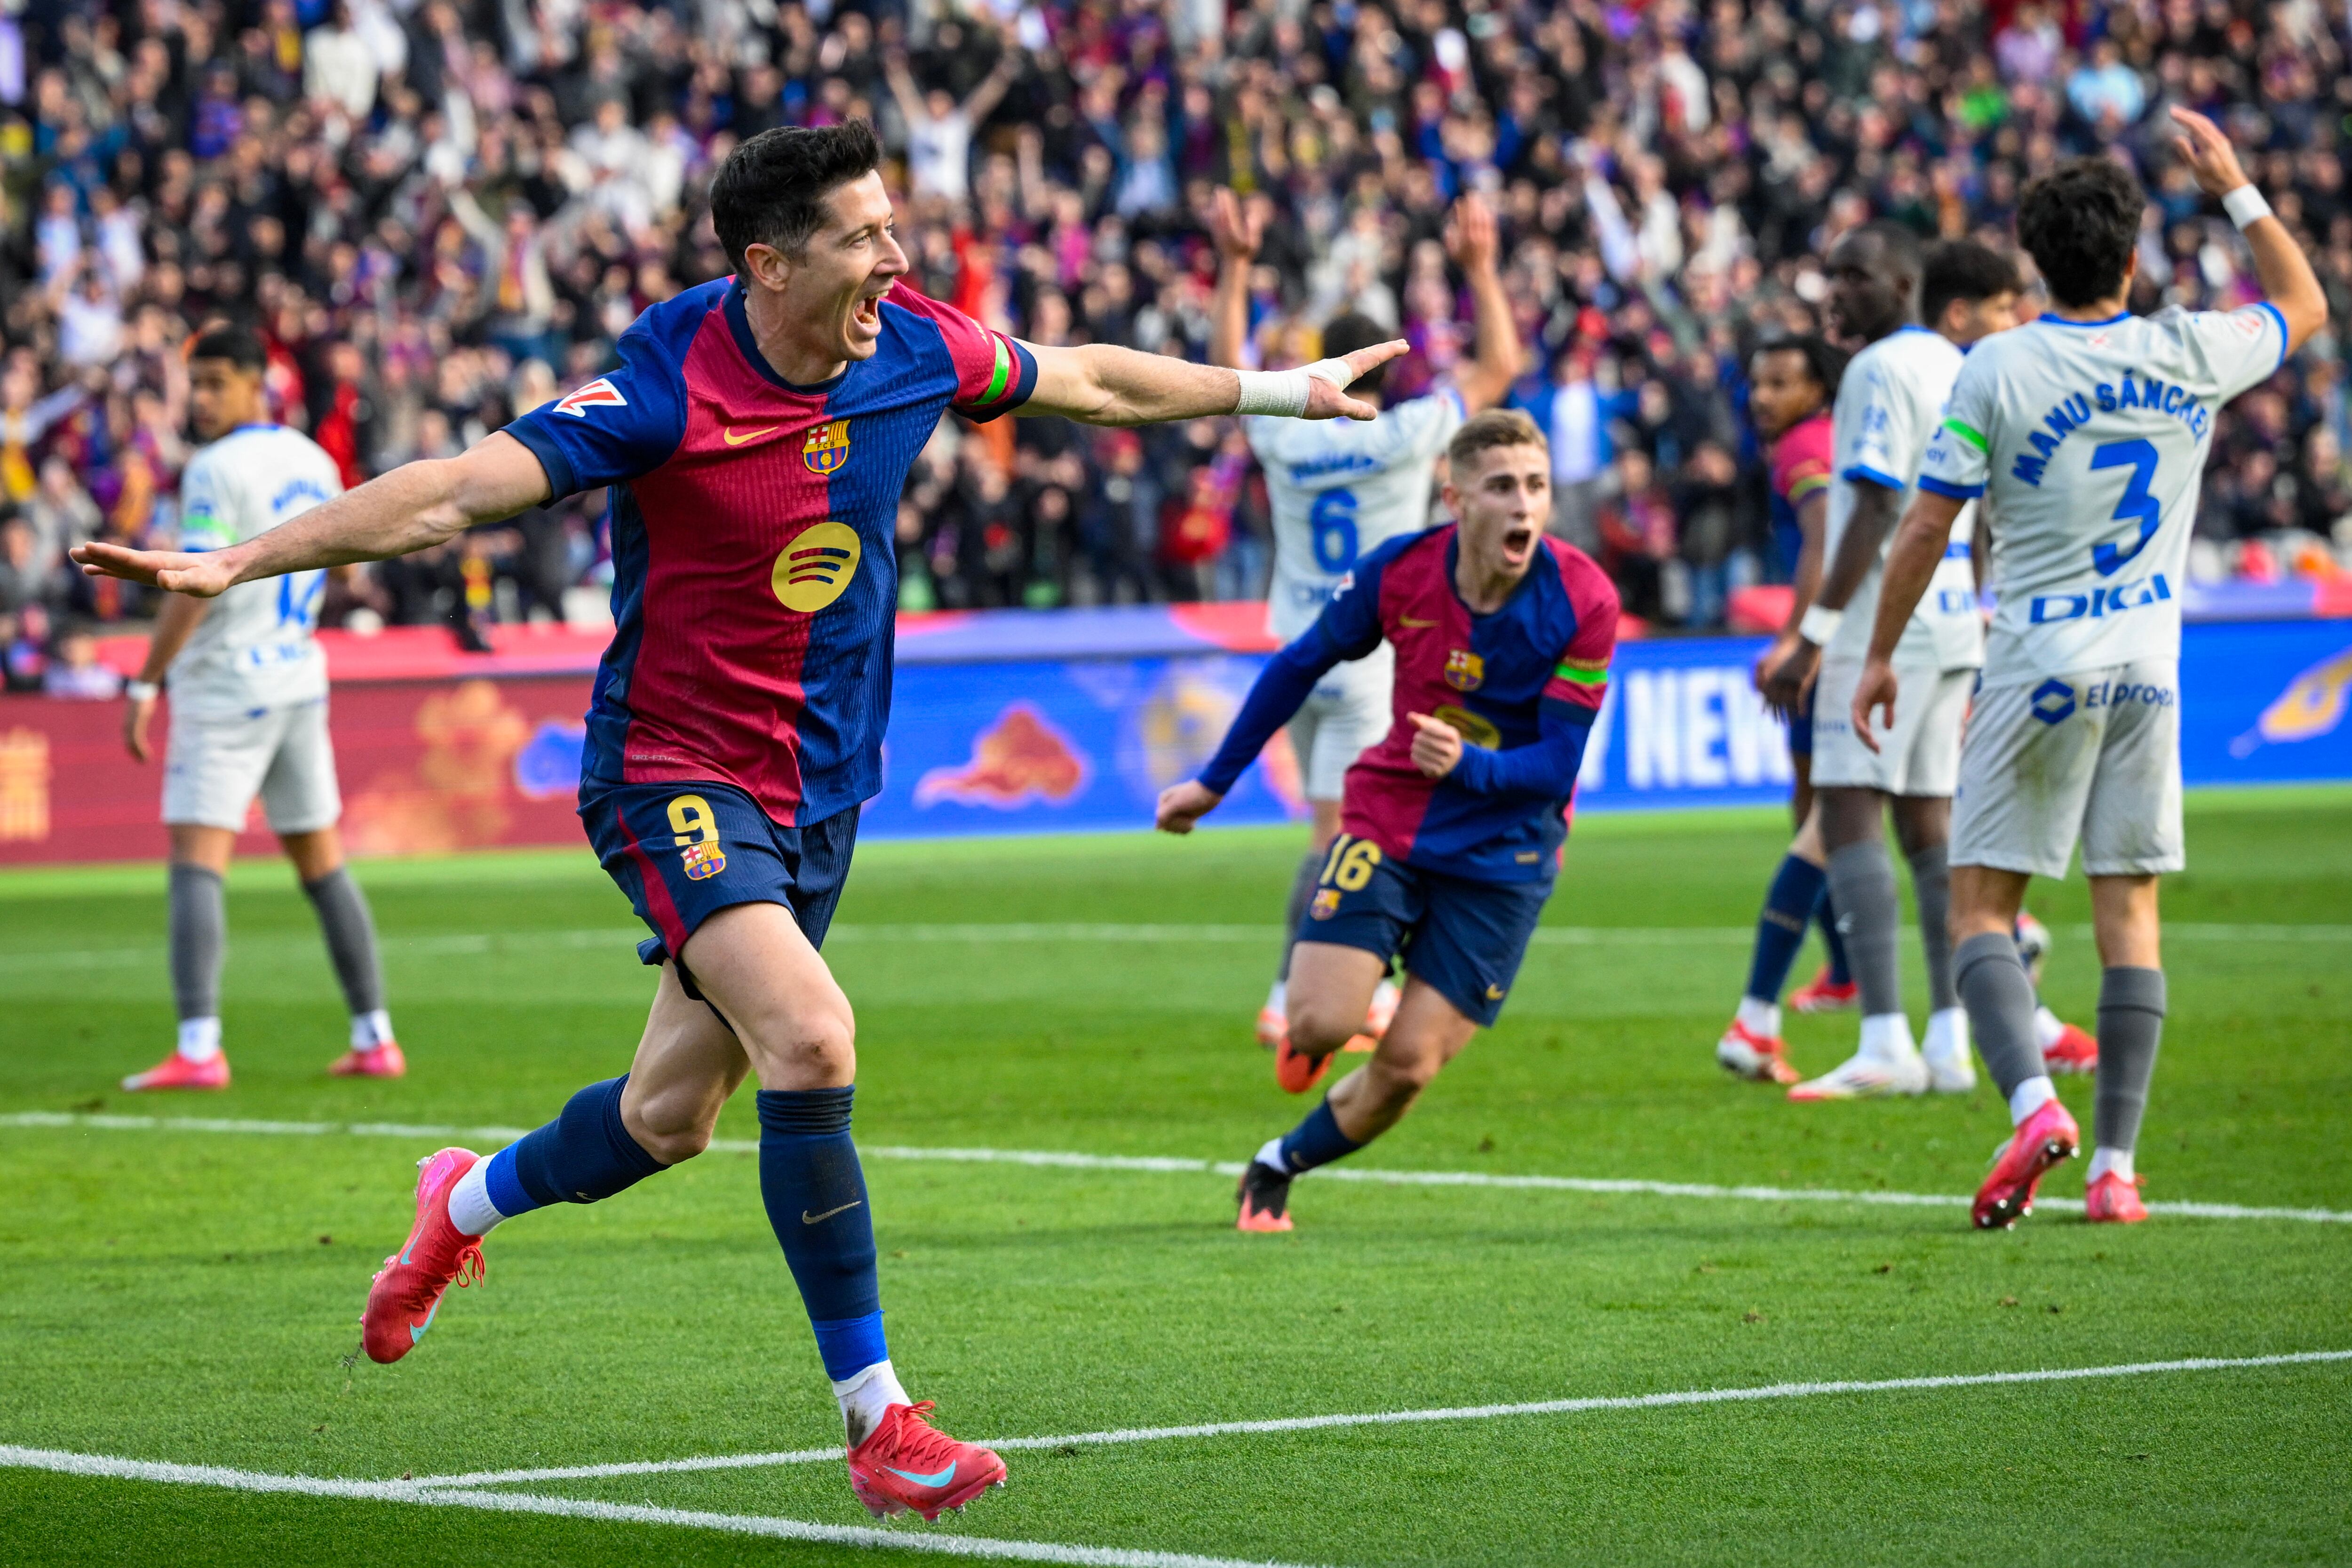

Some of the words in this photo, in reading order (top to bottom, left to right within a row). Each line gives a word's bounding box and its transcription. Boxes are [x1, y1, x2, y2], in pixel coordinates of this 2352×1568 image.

[2012, 391, 2091, 489] MANU
[1311, 488, 1359, 574] 6
[2089, 438, 2160, 576] 3
[2030, 573, 2172, 624] DIGI
[1624, 667, 1793, 791] NEW
[667, 794, 719, 847] 9
[1319, 833, 1382, 891] 16
